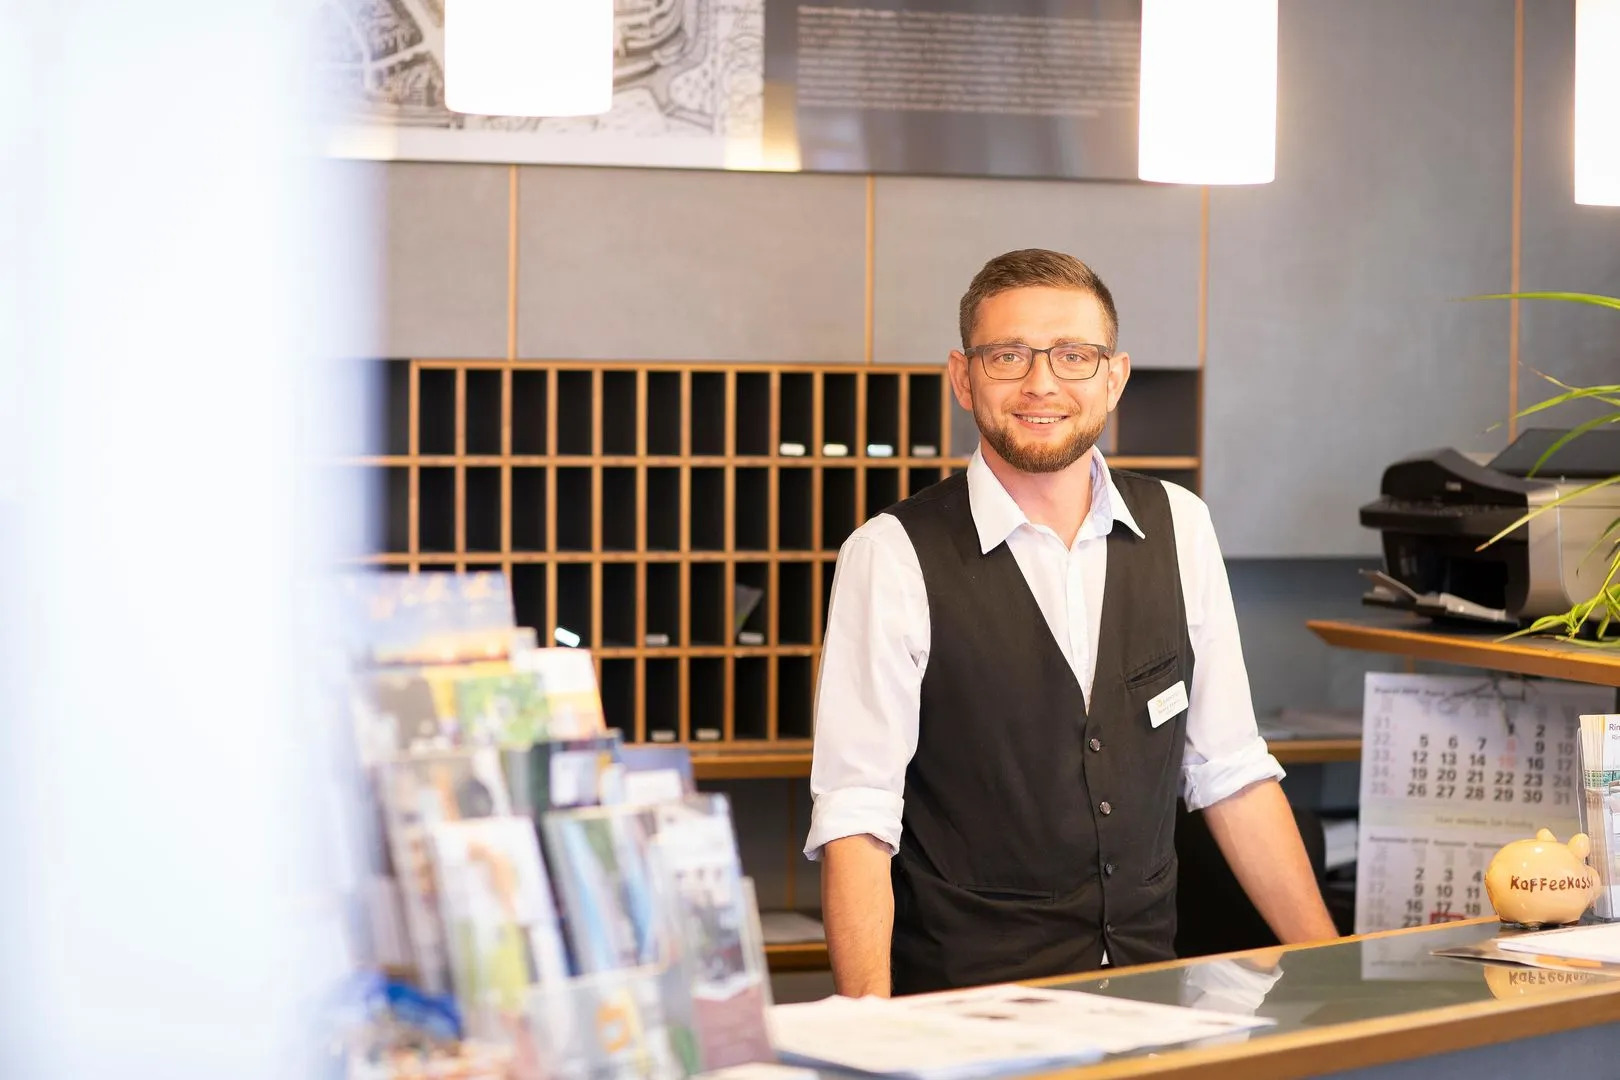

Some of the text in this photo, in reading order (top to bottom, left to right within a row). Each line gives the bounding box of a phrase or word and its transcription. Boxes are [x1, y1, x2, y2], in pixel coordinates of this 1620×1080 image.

[1536, 724, 1546, 738] 2
[1420, 734, 1429, 748] 5
[1448, 735, 1458, 749] 6
[1477, 736, 1488, 750] 7
[1535, 741, 1545, 754] 9
[1557, 742, 1574, 756] 10
[1412, 750, 1428, 764] 12
[1441, 752, 1457, 765] 13
[1469, 754, 1486, 767] 14
[1527, 757, 1544, 770] 16
[1557, 758, 1573, 772] 17
[1410, 767, 1428, 780] 19
[1437, 768, 1457, 782] 20
[1466, 770, 1484, 783] 21
[1494, 771, 1514, 785] 22
[1523, 773, 1543, 787] 23
[1553, 774, 1571, 788] 24
[1407, 783, 1427, 797] 26
[1436, 784, 1456, 799] 27
[1465, 786, 1485, 800] 28
[1494, 788, 1513, 802] 29
[1522, 790, 1543, 803] 30
[1553, 791, 1570, 805] 31
[1415, 867, 1482, 882] 2 3 4
[1413, 883, 1480, 899] 9 10 11
[1406, 899, 1481, 915] 16 17 18
